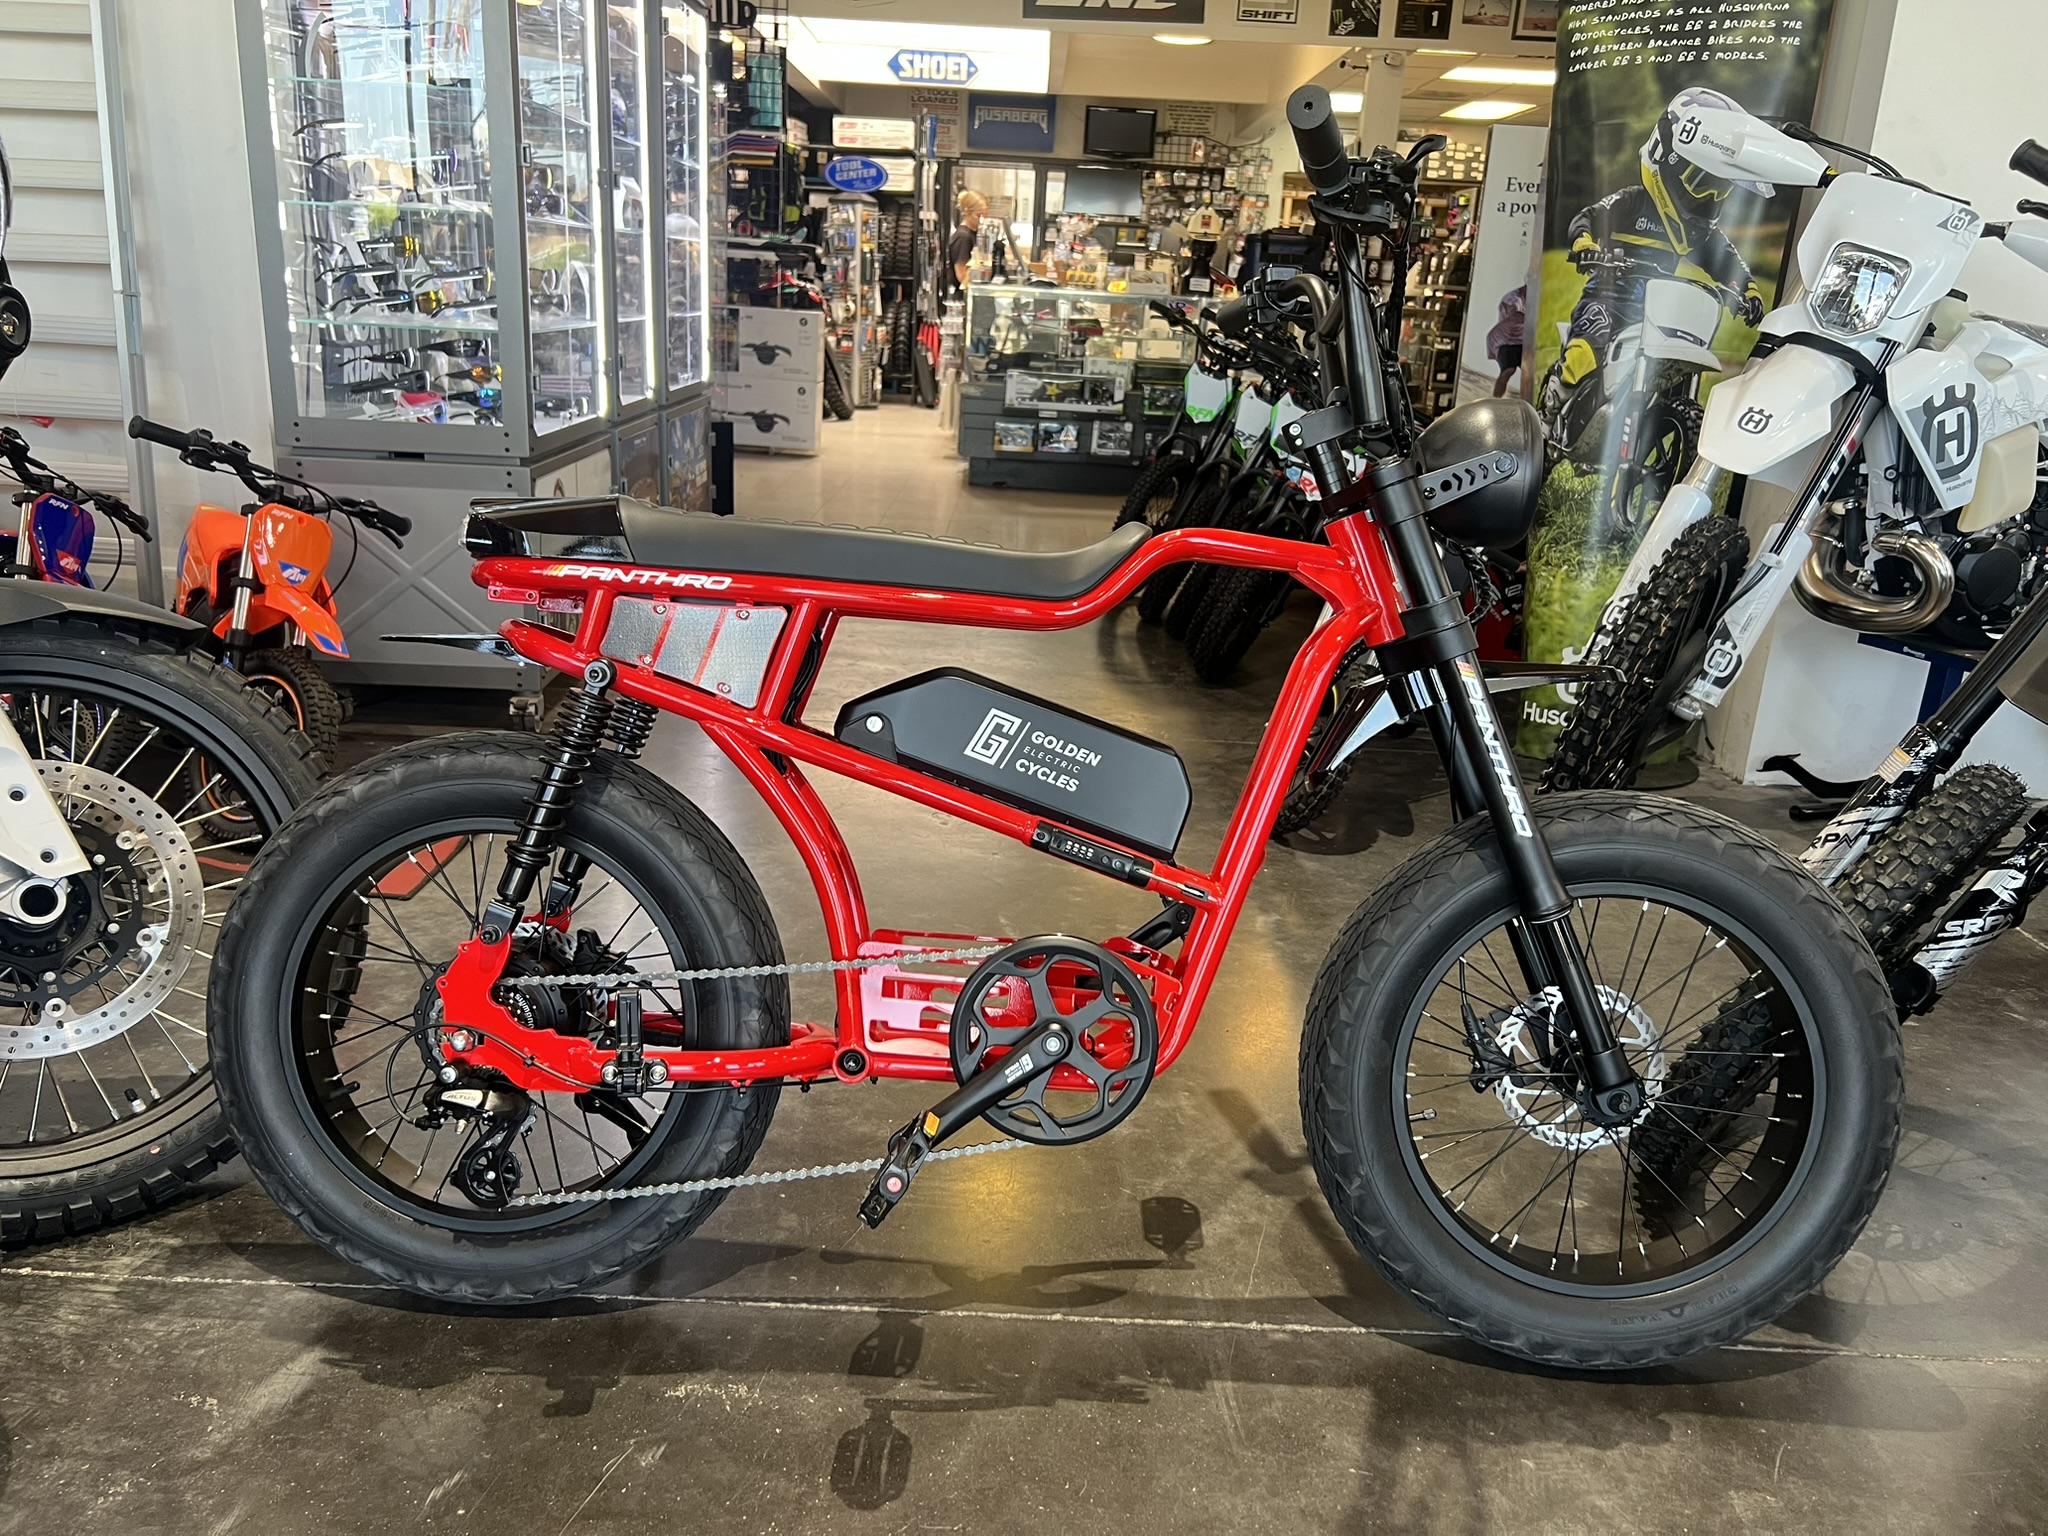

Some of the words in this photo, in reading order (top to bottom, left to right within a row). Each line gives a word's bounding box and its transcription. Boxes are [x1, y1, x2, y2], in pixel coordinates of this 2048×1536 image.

[1241, 9, 1294, 20] SHIFT
[1567, 19, 1587, 30] HIGH
[1591, 9, 1661, 25] STANDARDS
[1667, 7, 1684, 16] AS
[1689, 6, 1713, 14] ALL
[1718, 3, 1790, 13] HUSQVARNA
[1569, 0, 1616, 15] POWERED
[1571, 25, 1654, 43] MOTORCYCLES,
[1659, 23, 1680, 32] THE
[1684, 20, 1704, 31] EE
[1708, 20, 1718, 30] 2
[1722, 19, 1777, 29] BRIDGES
[1782, 21, 1803, 29] THE
[1570, 47, 1589, 58] GAP
[1592, 42, 1643, 55] BETWEEN
[1647, 37, 1702, 49] BALANCE
[1707, 34, 1744, 45] BIKES
[1749, 35, 1775, 44] AND
[1780, 37, 1801, 45] THE
[898, 53, 969, 81] SHOEI
[1568, 60, 1608, 72] LARGER
[1612, 56, 1630, 67] EE
[1634, 55, 1643, 65] 3
[1648, 54, 1672, 63] AND
[1677, 51, 1697, 62] EE
[1715, 51, 1768, 60] MODELS.
[911, 96, 958, 104] LOANED
[974, 106, 1049, 134] HUSABERG
[1707, 138, 1737, 156] Husqvarna
[835, 160, 863, 171] TOOL
[835, 168, 877, 181] CENTER
[1497, 201, 1506, 213] a
[1647, 222, 1665, 232] Hus
[1945, 478, 1973, 493] Husqvarna
[557, 564, 733, 591] PANTHRO
[1023, 745, 1081, 774] ELECTRIC
[1031, 730, 1102, 767] GOLDEN
[1462, 675, 1533, 838] PANTHRO
[1015, 758, 1080, 792] CYCLES
